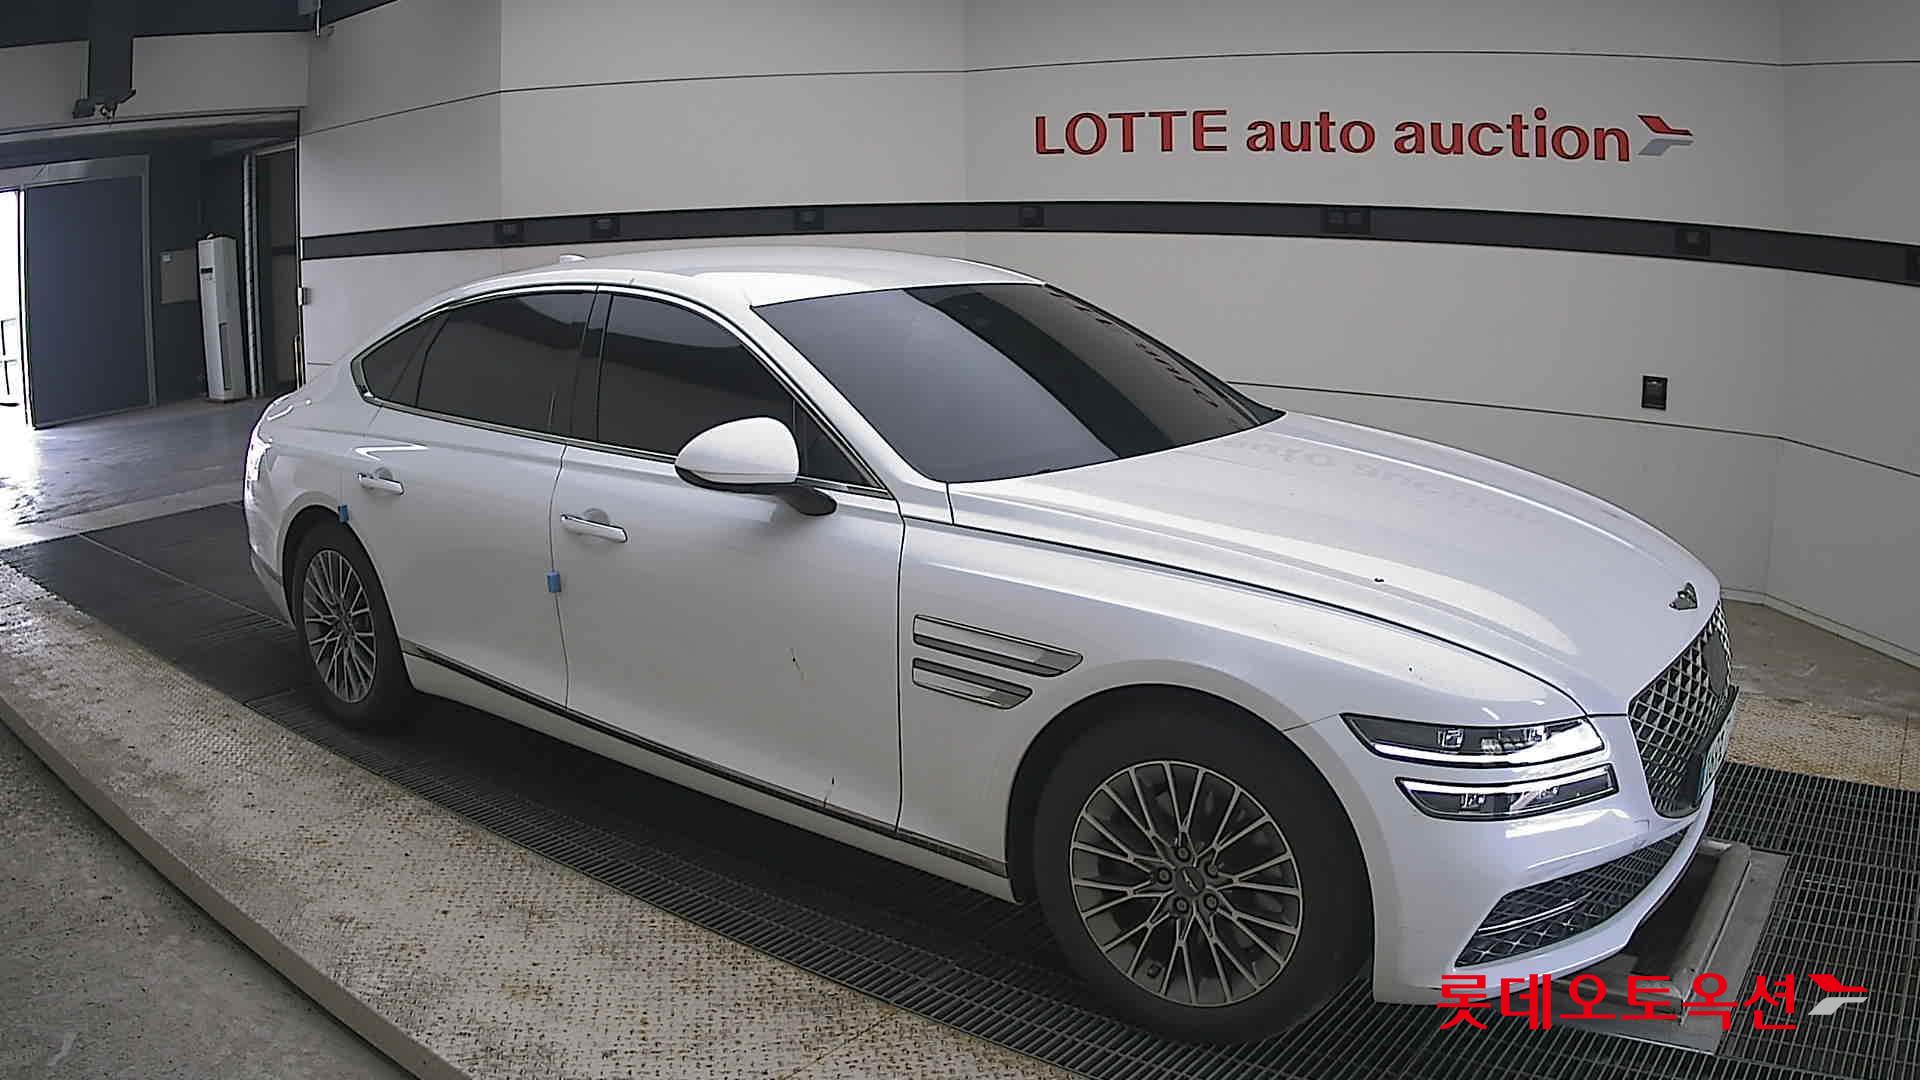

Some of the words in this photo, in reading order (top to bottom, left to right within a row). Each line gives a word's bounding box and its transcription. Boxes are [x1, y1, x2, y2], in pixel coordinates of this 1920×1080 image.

[1035, 110, 1229, 155] LOTTE
[1246, 111, 1376, 154] auto
[1394, 107, 1631, 162] auction
